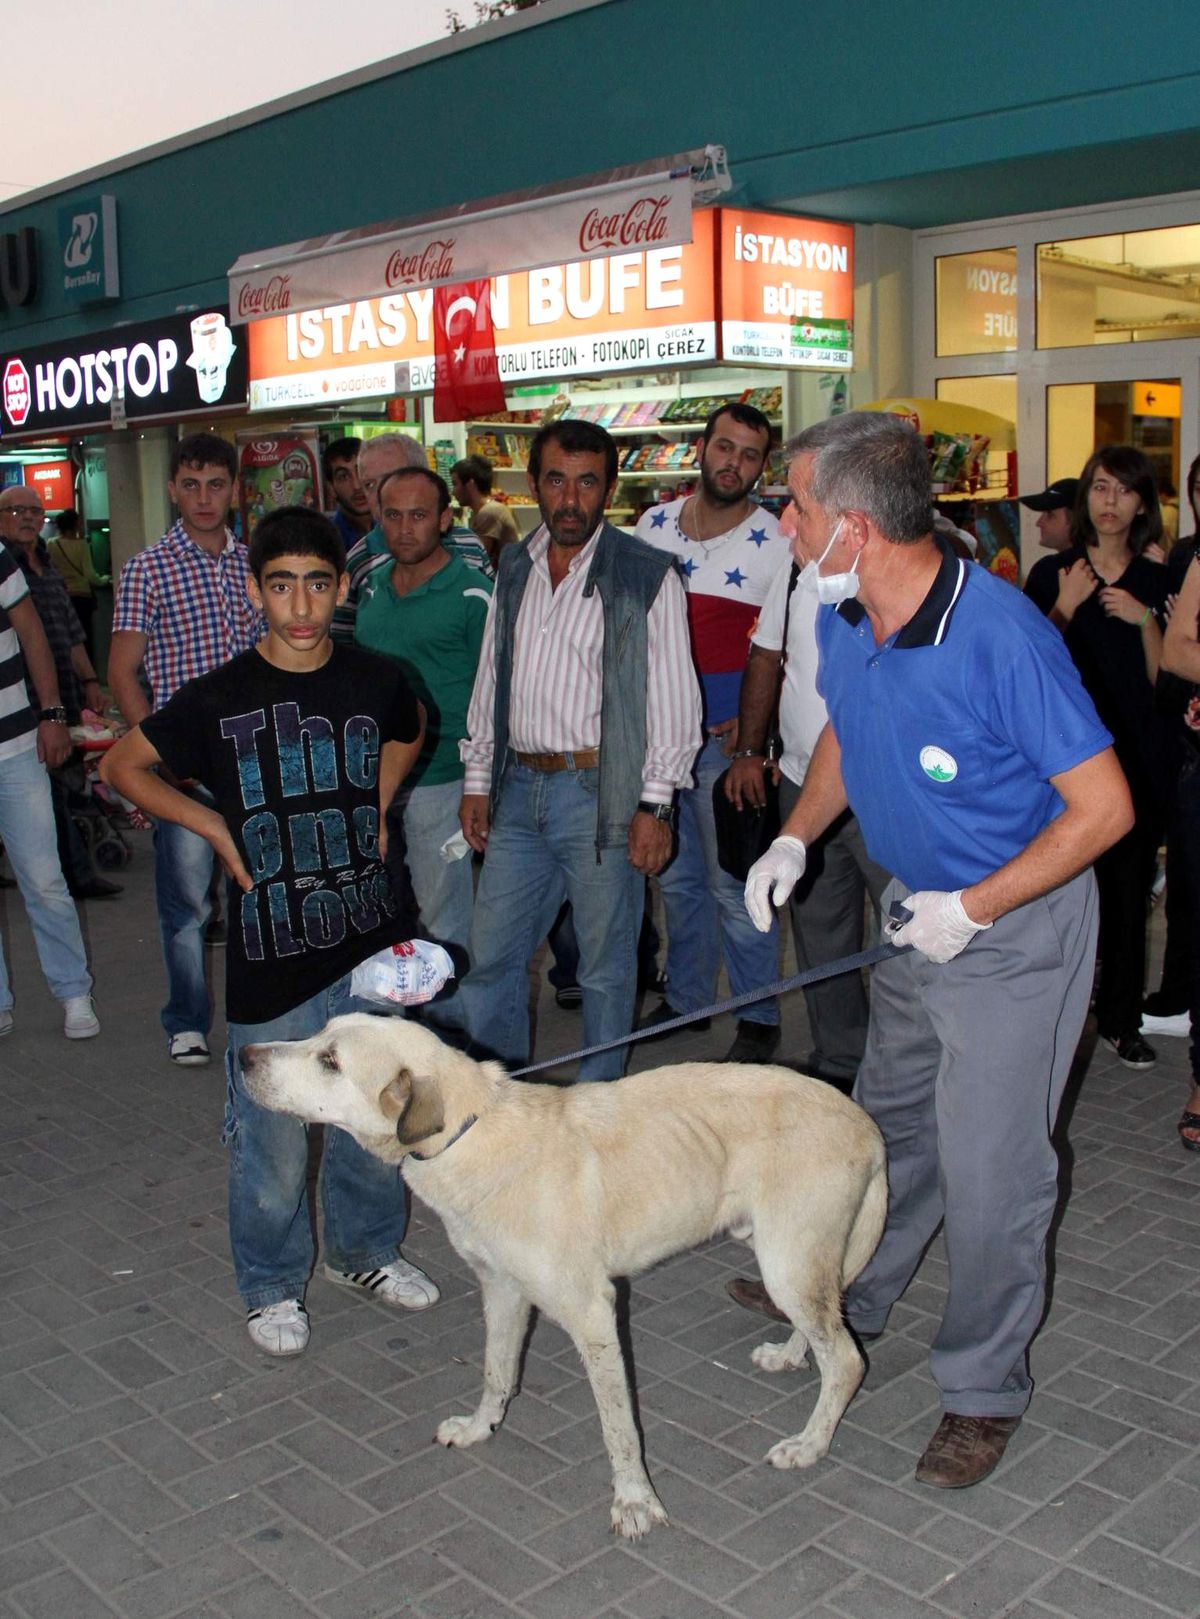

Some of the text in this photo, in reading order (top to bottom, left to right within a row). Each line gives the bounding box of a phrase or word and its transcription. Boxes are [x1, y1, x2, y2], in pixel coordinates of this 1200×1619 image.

[735, 226, 847, 272] İSTASYON
[764, 282, 823, 318] BÜFE
[531, 345, 578, 371] TELEFON
[657, 338, 705, 361] ÇEREZ
[35, 338, 178, 413] HOTSTOP
[334, 374, 387, 393] vodafone
[220, 702, 379, 810] The
